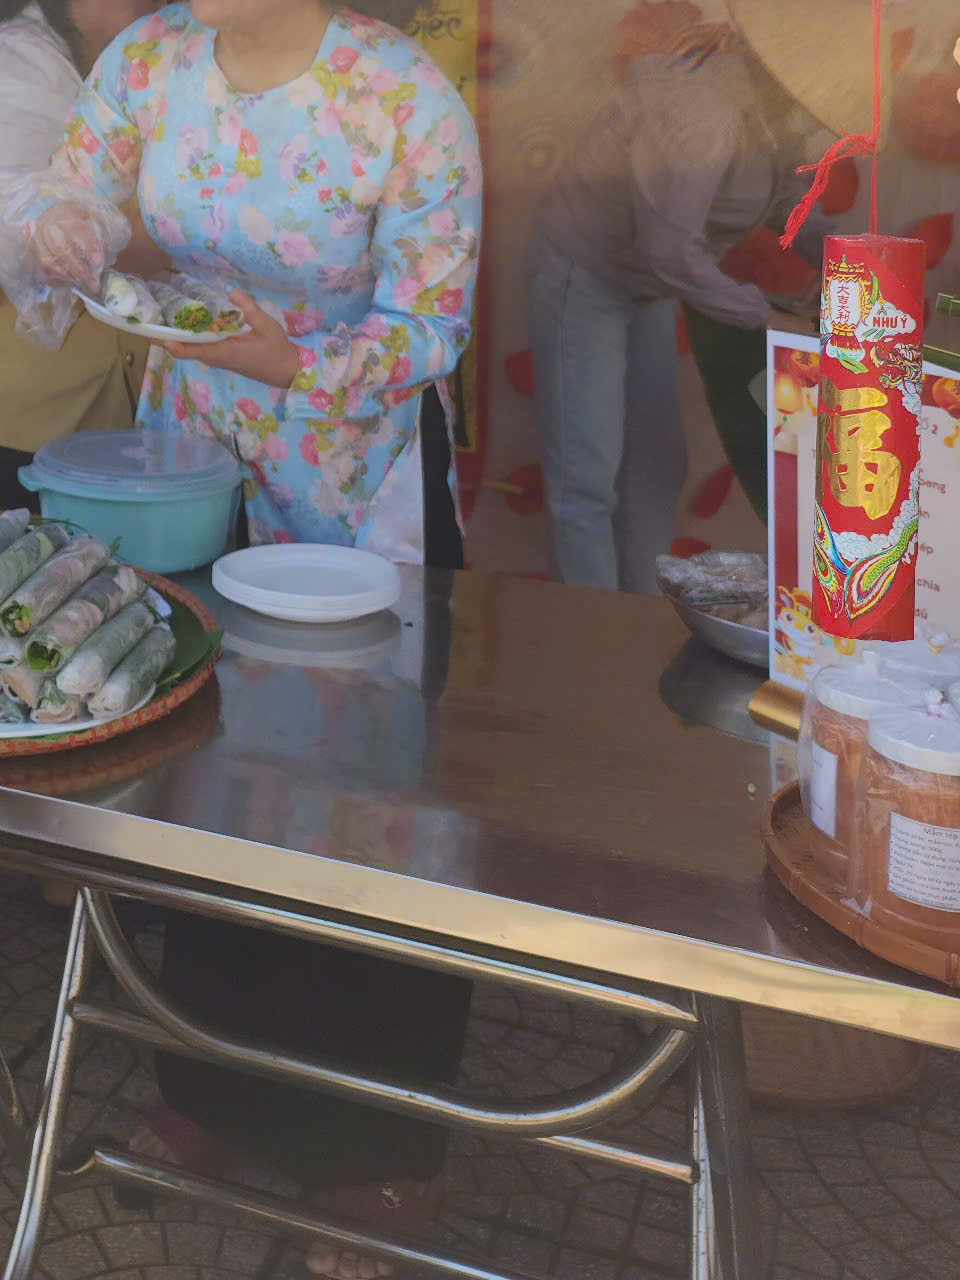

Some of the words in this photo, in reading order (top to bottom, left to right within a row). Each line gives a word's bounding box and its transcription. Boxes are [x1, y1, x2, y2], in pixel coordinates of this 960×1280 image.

[837, 285, 850, 322] 大吉大利
[872, 315, 898, 329] NHƯ
[899, 314, 908, 329] Ý
